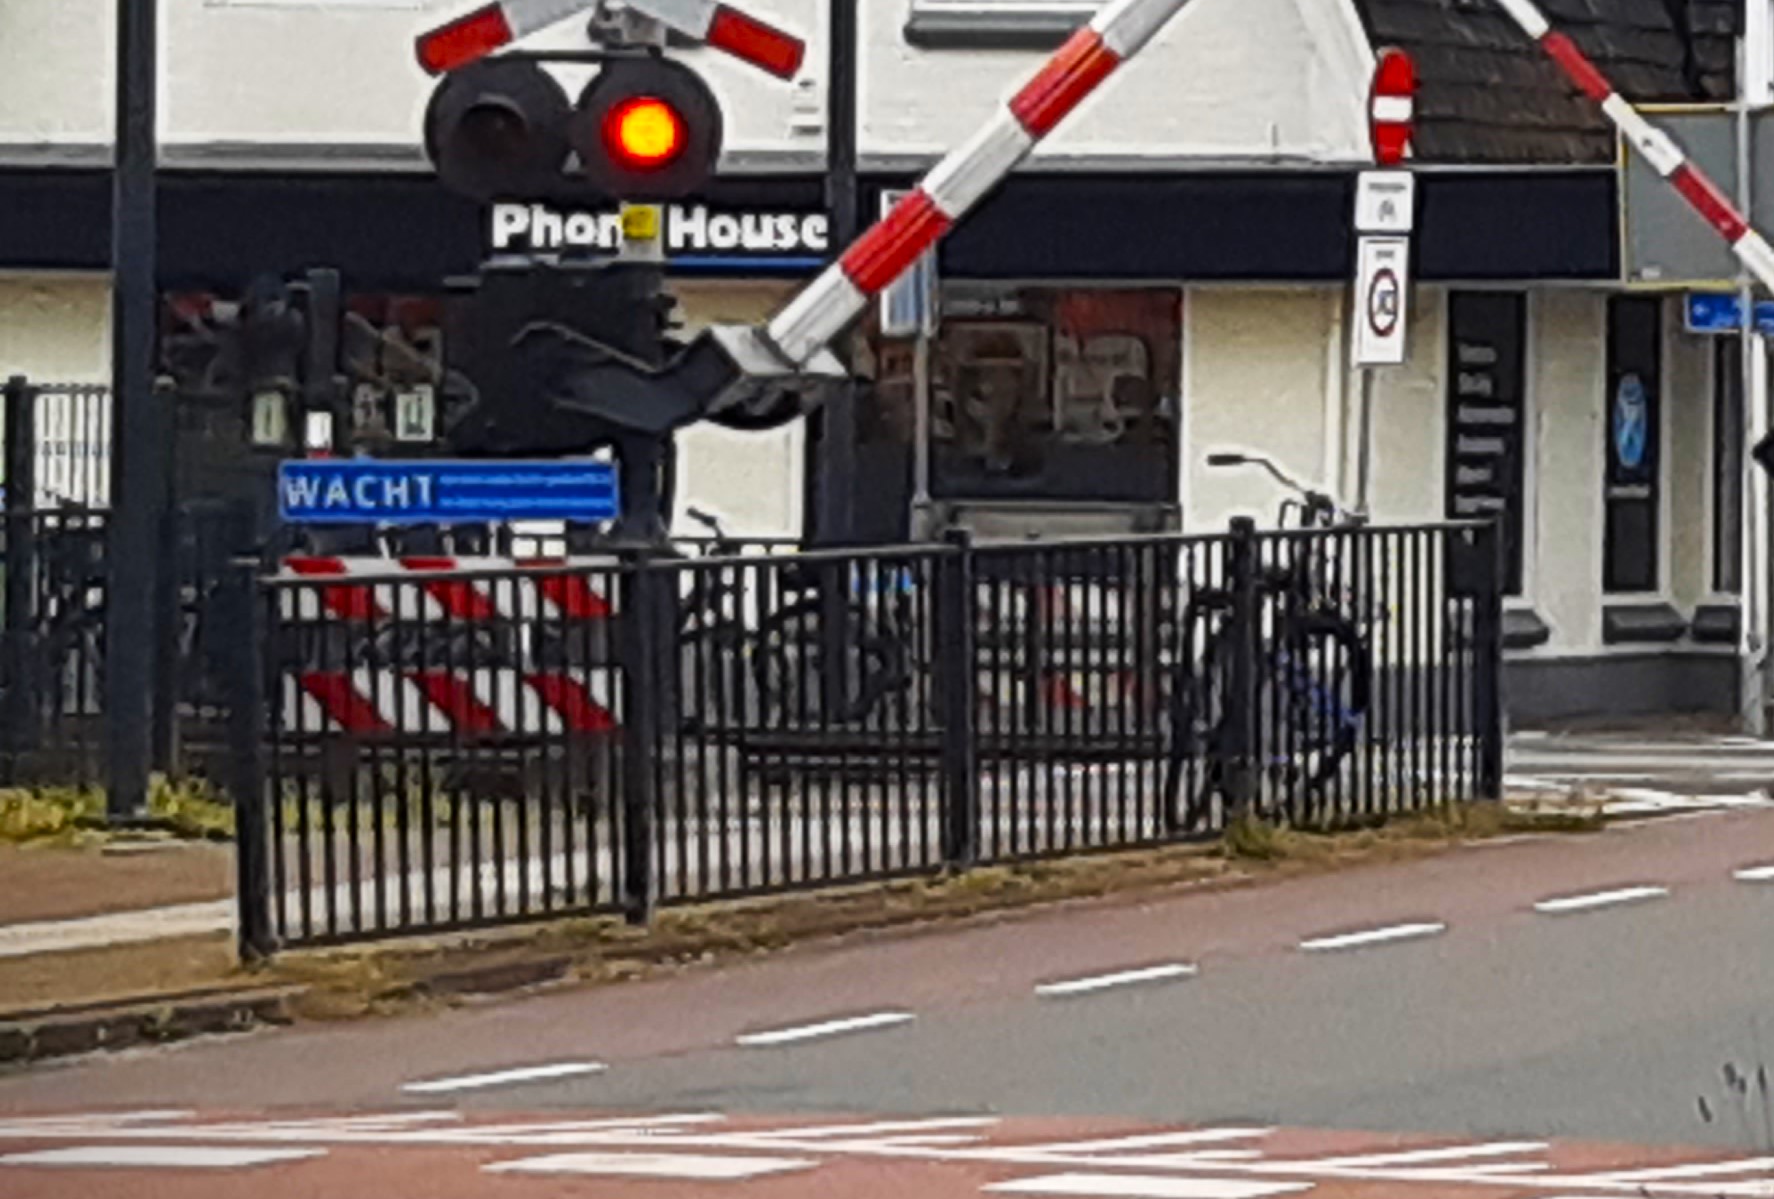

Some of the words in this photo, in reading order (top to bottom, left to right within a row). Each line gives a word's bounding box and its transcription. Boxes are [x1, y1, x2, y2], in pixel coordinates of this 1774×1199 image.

[492, 204, 624, 249] Phon
[668, 205, 828, 249] House
[284, 474, 434, 509] WACHT
